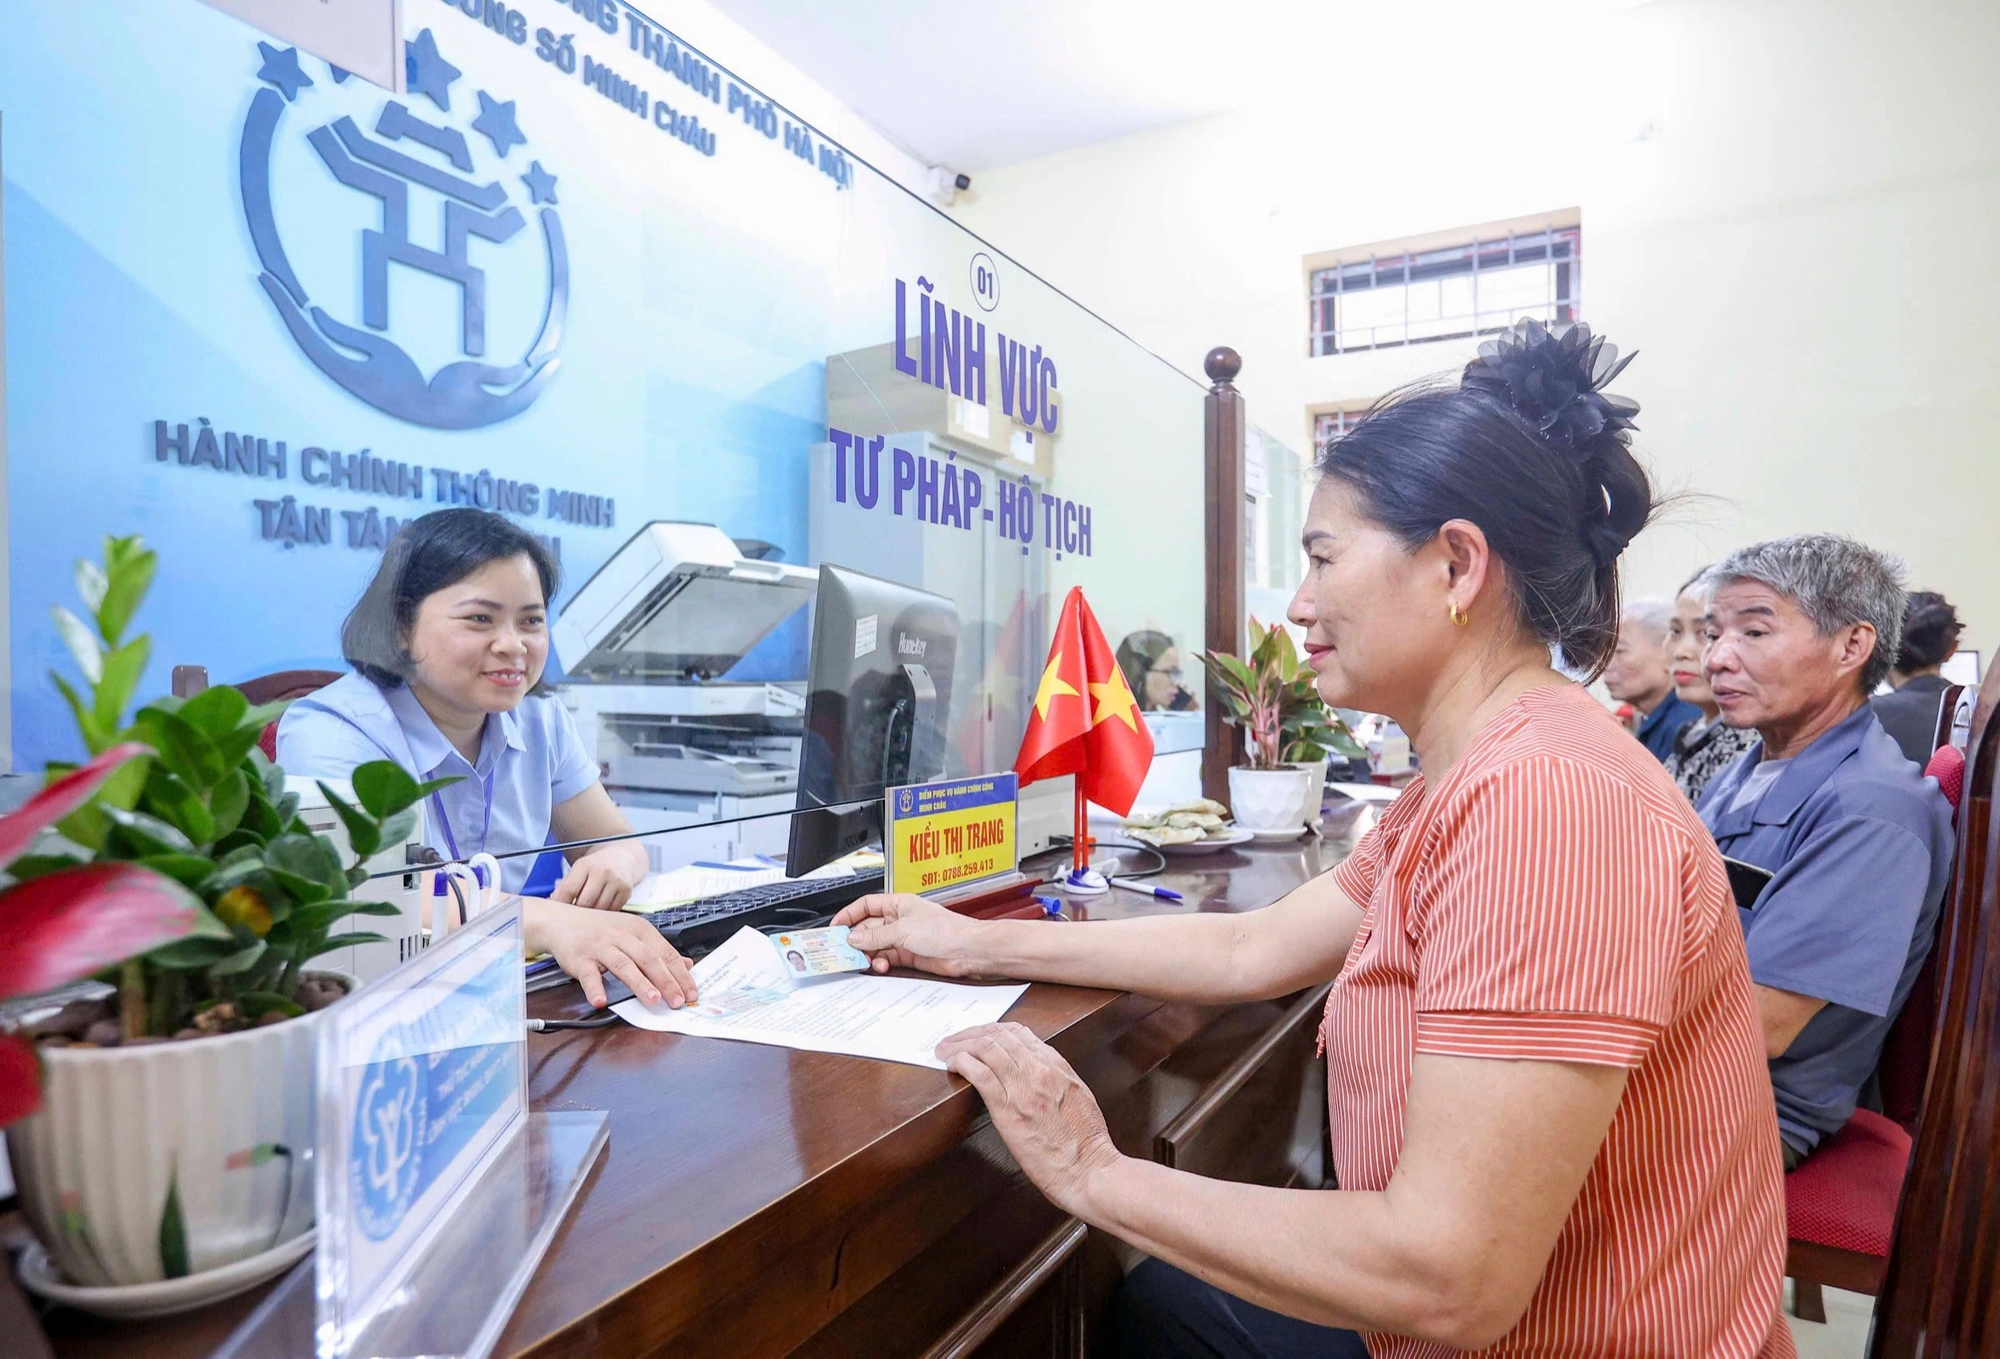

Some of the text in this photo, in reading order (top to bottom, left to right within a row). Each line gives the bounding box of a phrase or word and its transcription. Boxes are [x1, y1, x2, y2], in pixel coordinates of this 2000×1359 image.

[536, 27, 576, 74] SỐ
[584, 54, 649, 120] MINH
[654, 100, 717, 157] CHÂU
[553, 0, 618, 34] NG
[625, 11, 720, 104] THÀNH
[784, 120, 815, 165] HÀ
[977, 265, 993, 300] 01
[895, 275, 1058, 444] LĨNH VỰC
[155, 416, 615, 528] HÀNH CHÍNH THÔNG MINH
[253, 494, 331, 550] TẬN
[829, 427, 885, 510] TƯ
[1041, 492, 1092, 561] TỊCH
[909, 818, 1004, 863] KIỀU THỊ TRANG
[921, 858, 994, 887] SĐT: 0788.259.413
